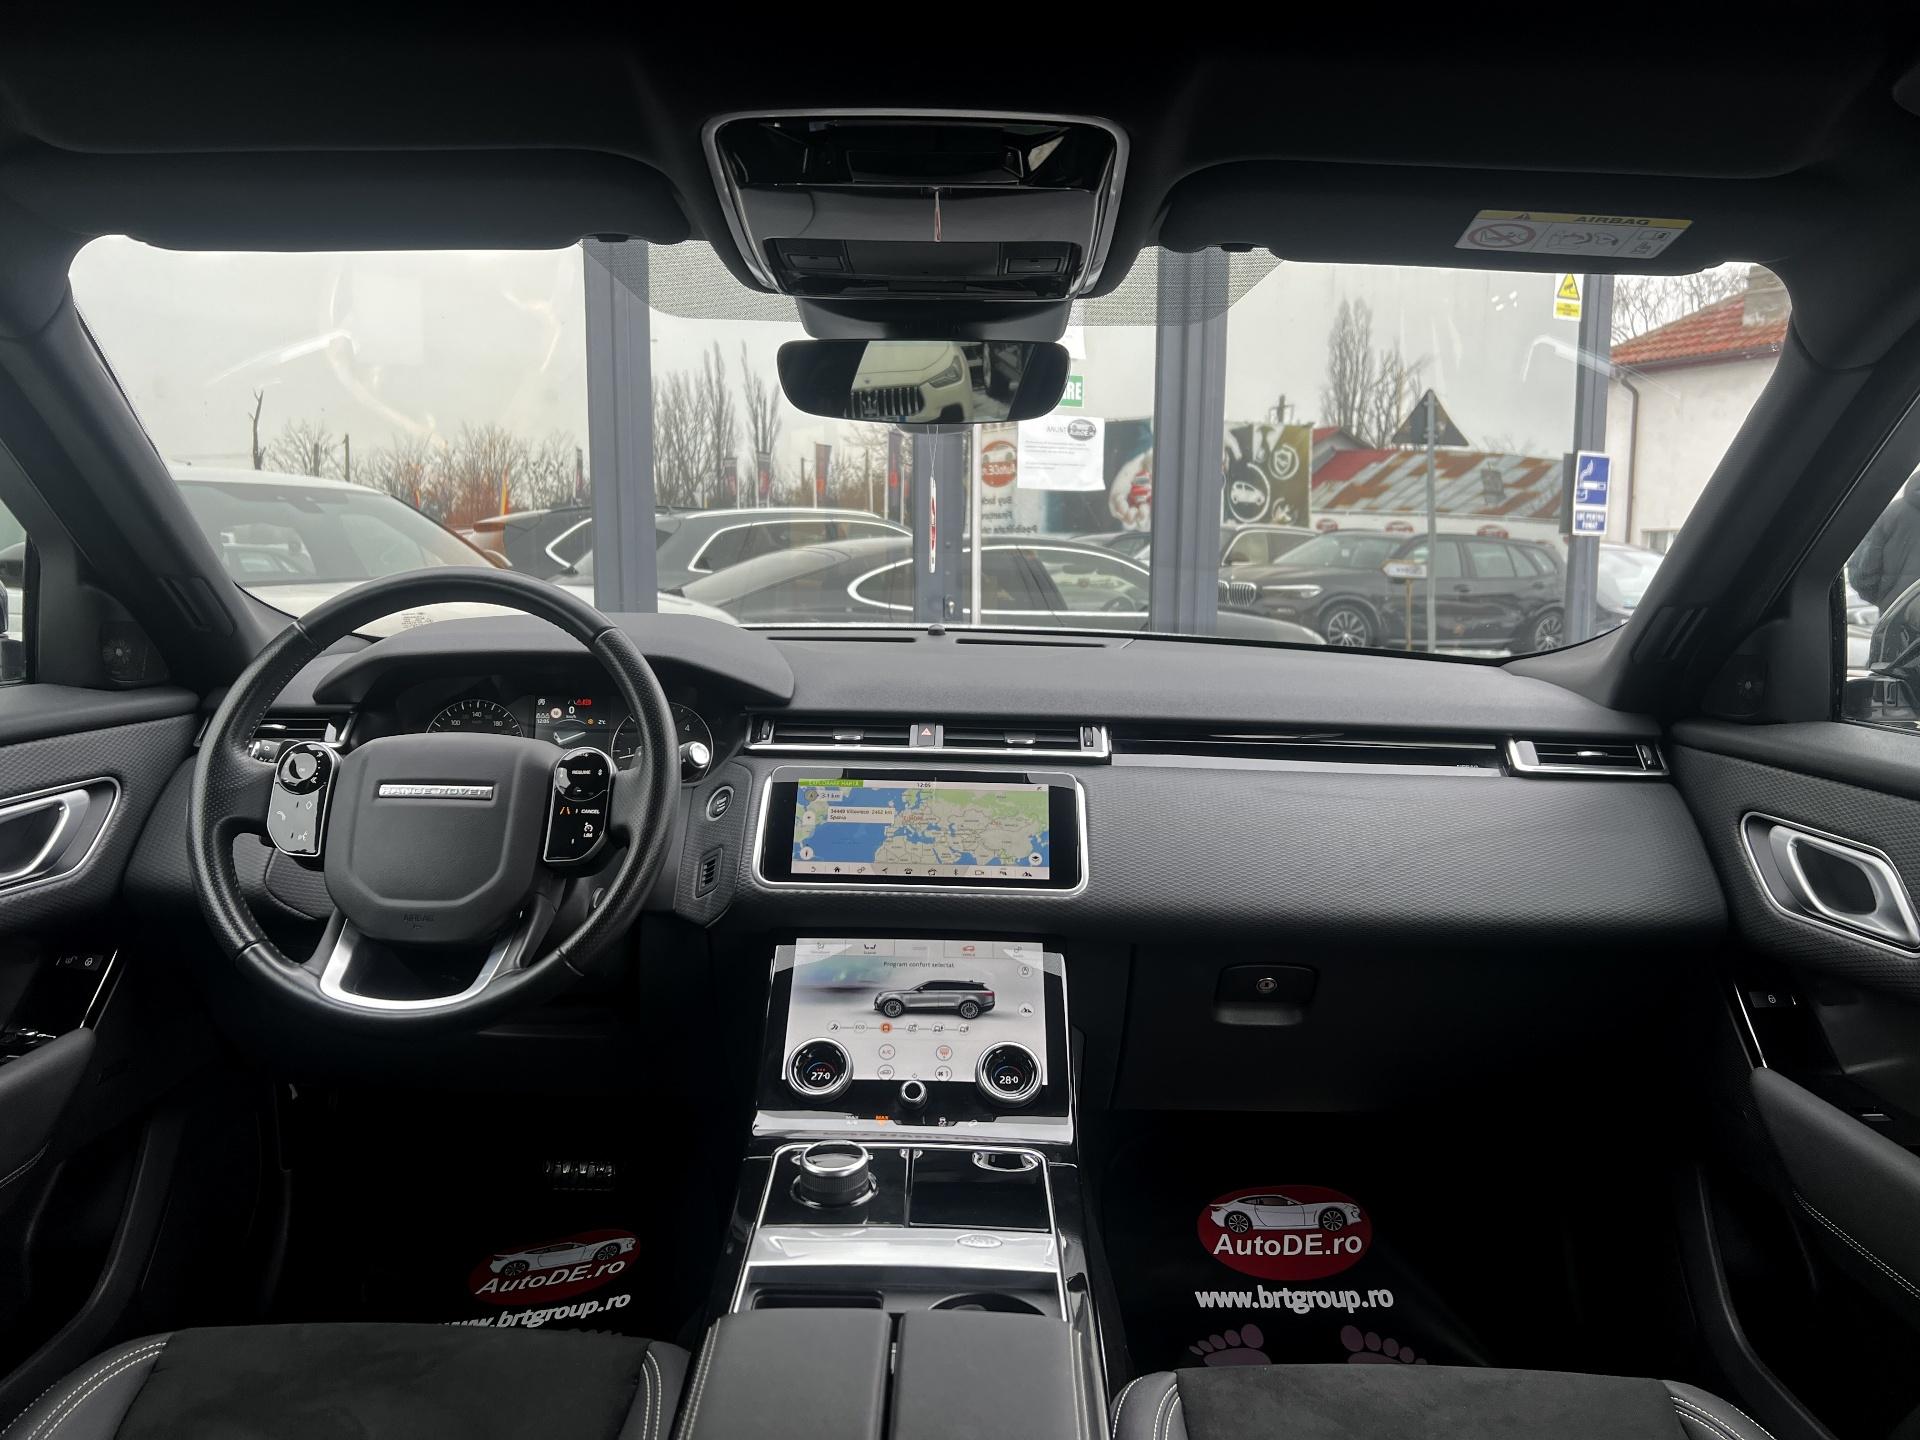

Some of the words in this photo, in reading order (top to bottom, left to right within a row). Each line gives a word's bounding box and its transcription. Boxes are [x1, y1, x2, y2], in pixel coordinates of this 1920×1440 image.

[1574, 216, 1650, 226] AIRBAG
[568, 706, 575, 714] 0
[381, 786, 433, 796] RANGE
[439, 788, 491, 798] ROVER
[1213, 1234, 1363, 1256] AutoDE.ro
[475, 1260, 626, 1295] AutoDE.ro
[1195, 1285, 1394, 1314] www.brtgroup.ro
